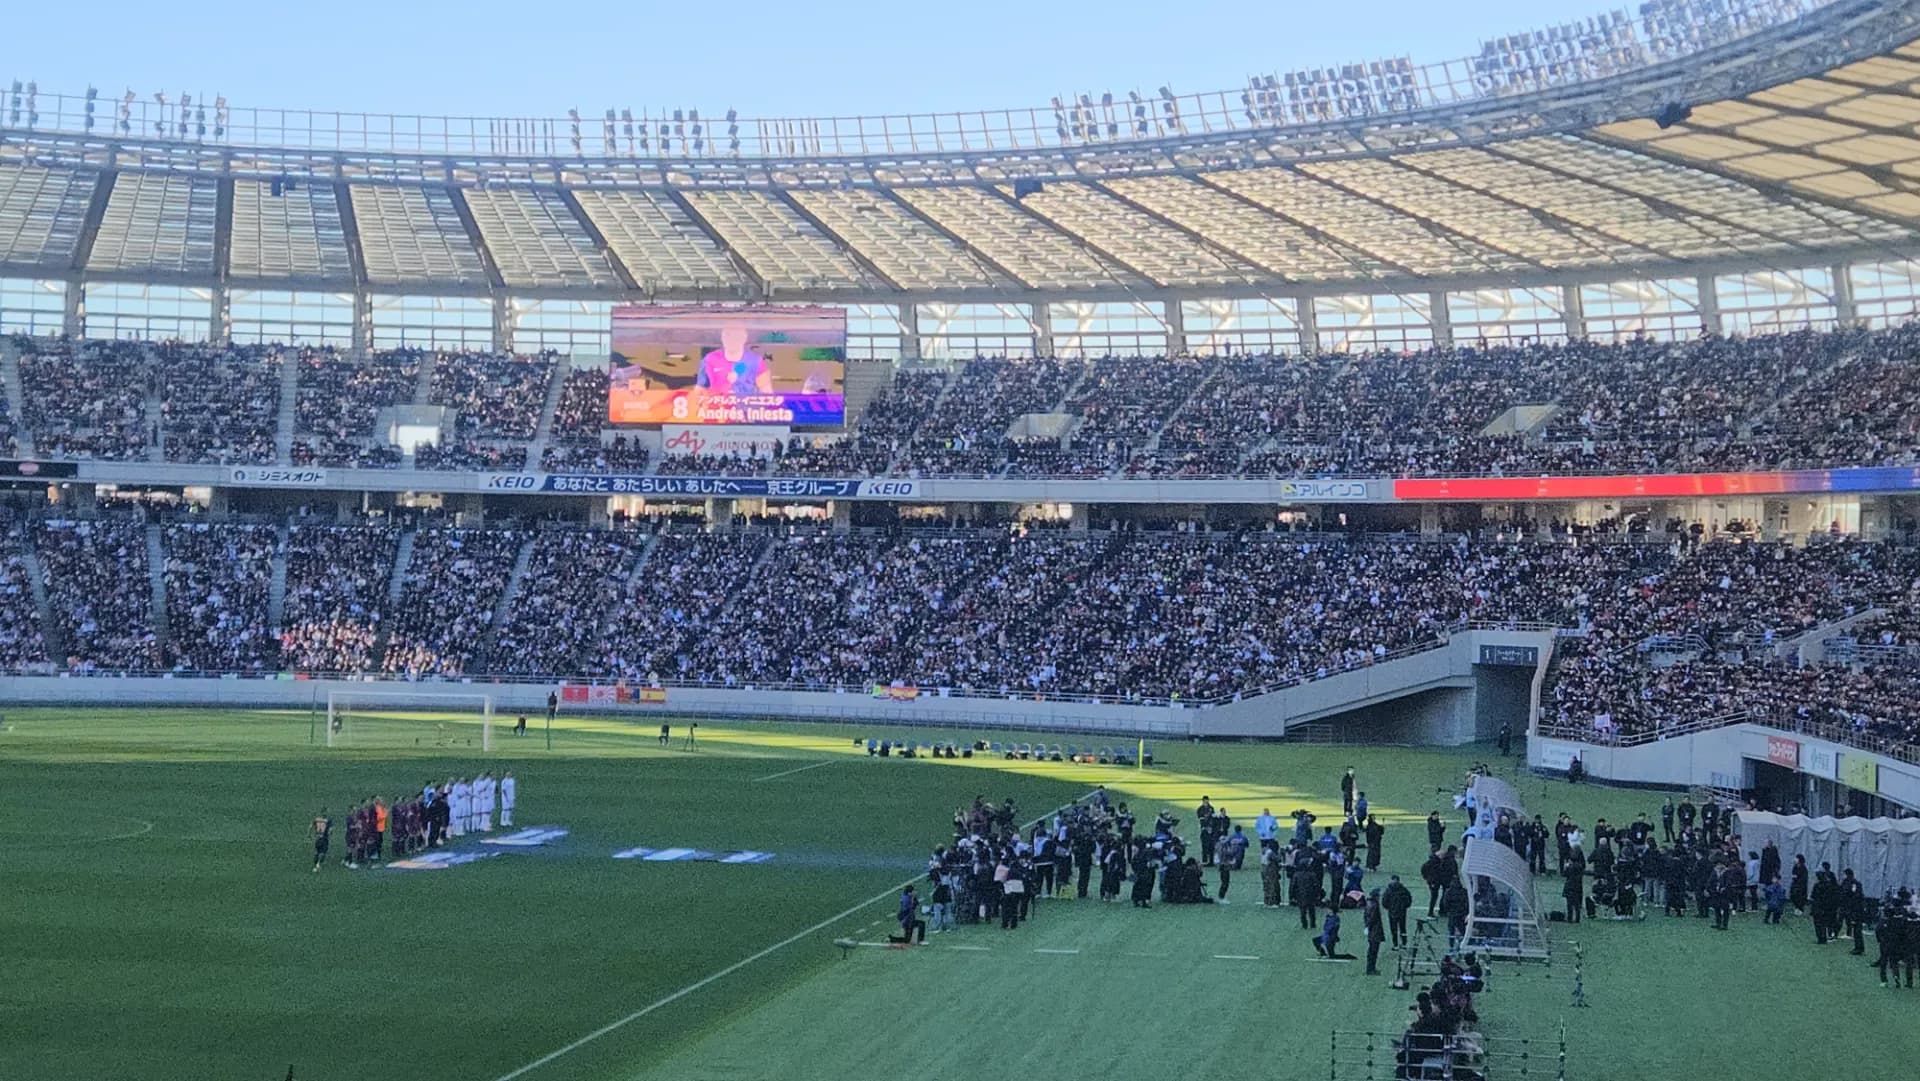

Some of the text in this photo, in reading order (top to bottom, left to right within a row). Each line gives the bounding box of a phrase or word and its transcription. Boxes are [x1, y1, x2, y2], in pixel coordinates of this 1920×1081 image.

[673, 396, 688, 419] 8
[697, 406, 794, 421] Andrés Iniesta
[488, 476, 535, 489] KEIO
[553, 477, 849, 494] あなたと あたらしい あしたへ 京王グループ
[868, 482, 913, 495] KEIO
[1298, 484, 1365, 497] アルインコ
